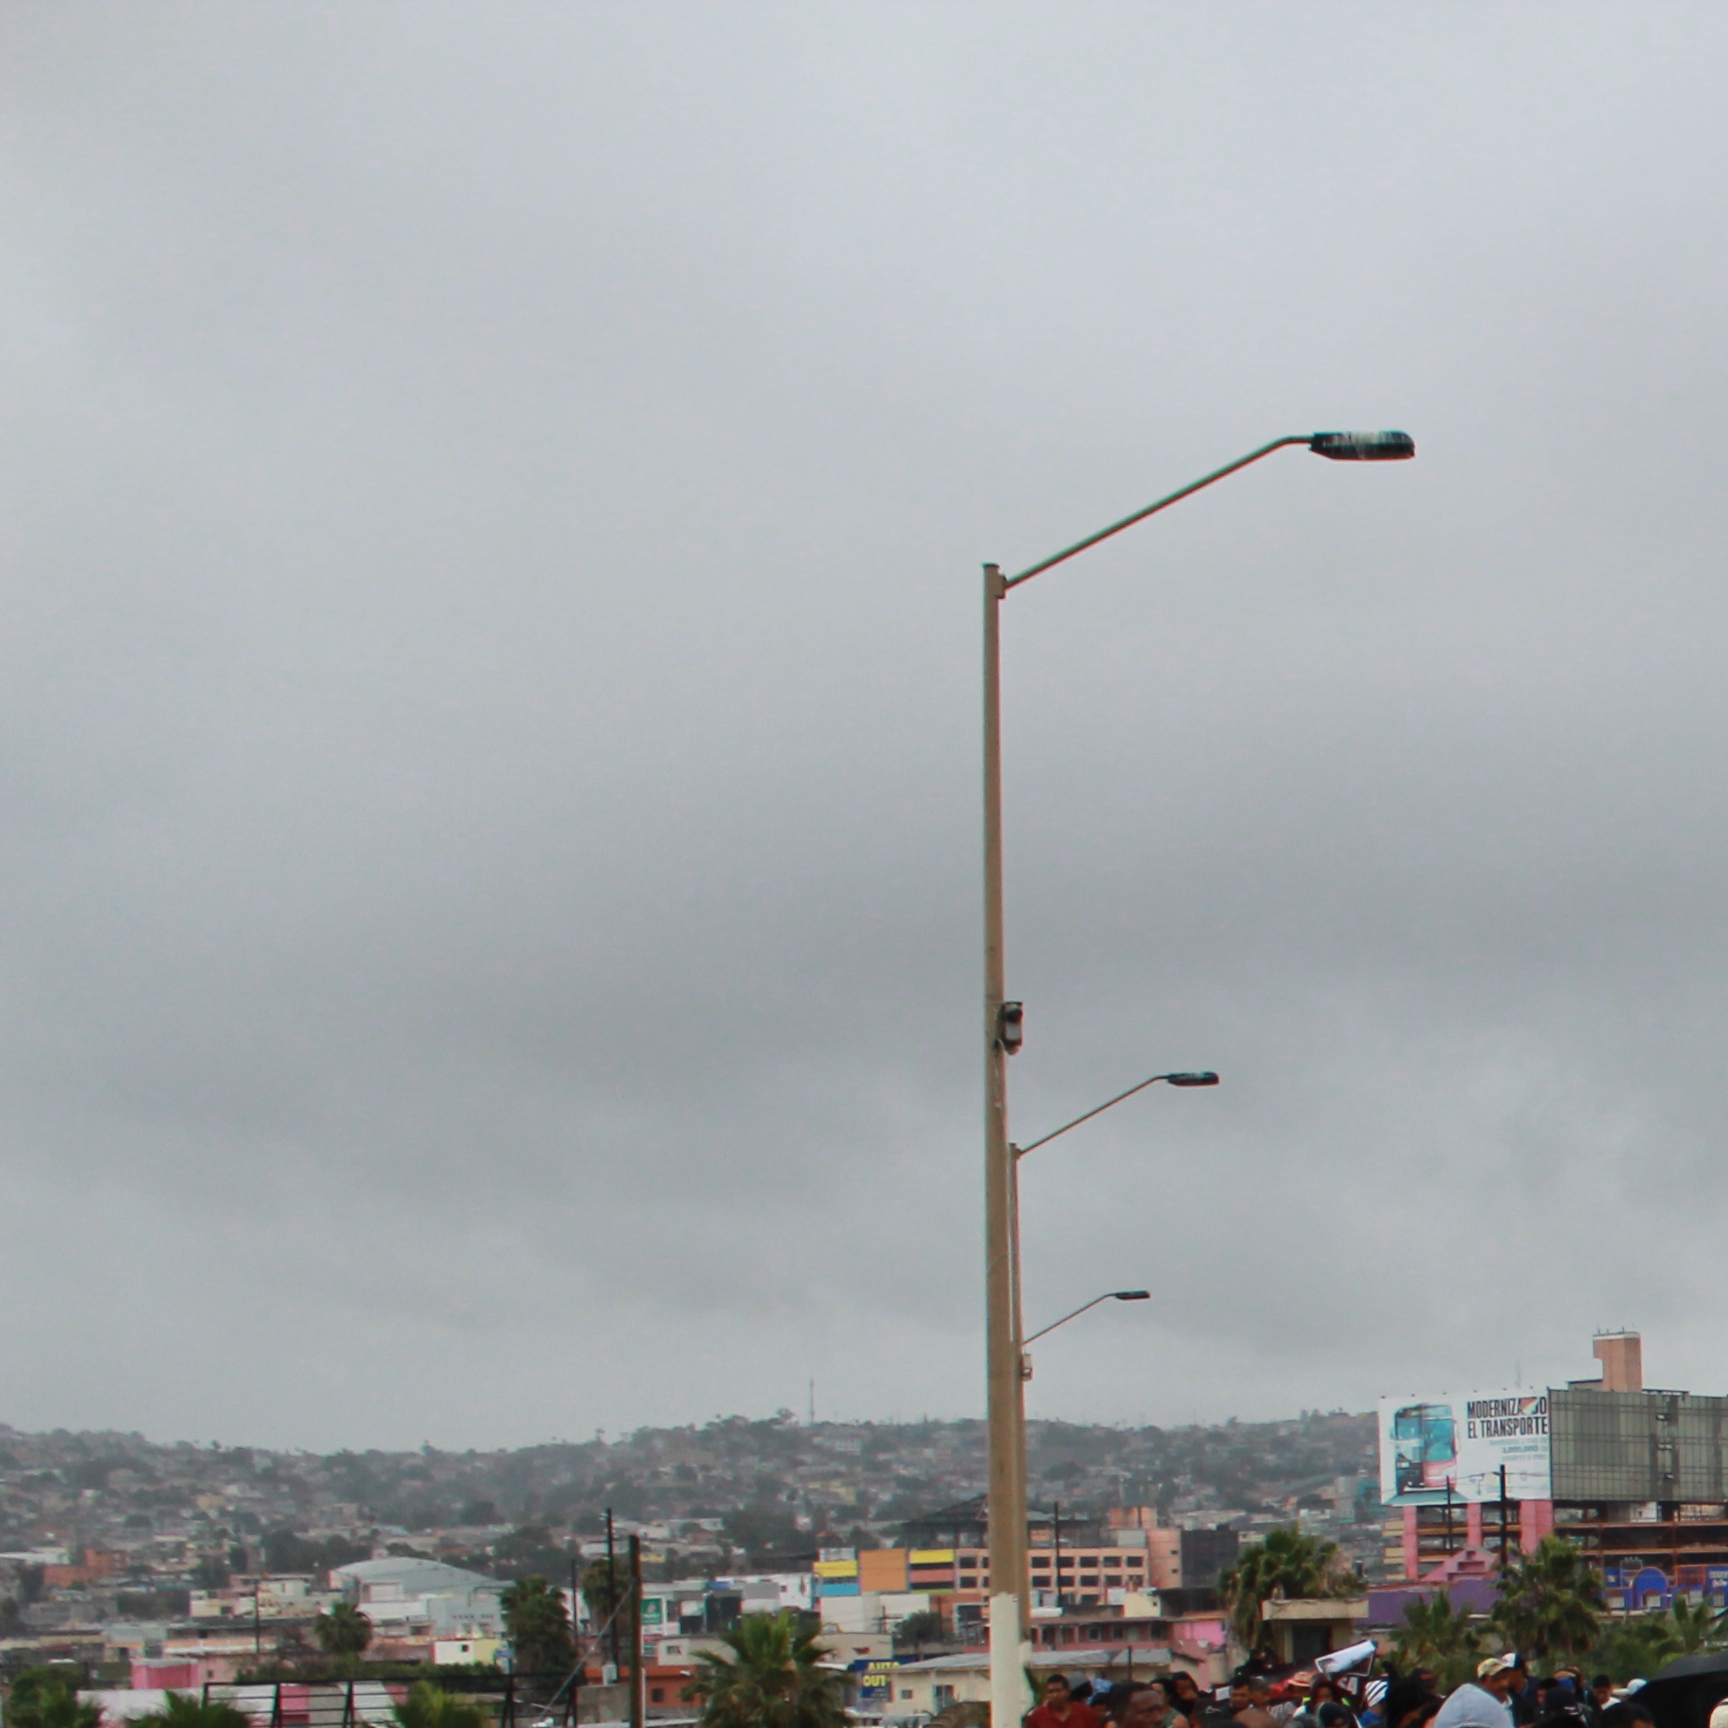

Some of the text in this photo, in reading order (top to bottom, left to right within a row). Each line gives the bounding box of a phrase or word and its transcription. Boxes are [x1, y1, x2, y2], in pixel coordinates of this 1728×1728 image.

[1467, 1396, 1548, 1419] MODERNIZADO
[1467, 1416, 1549, 1439] EL TRANSPORTE
